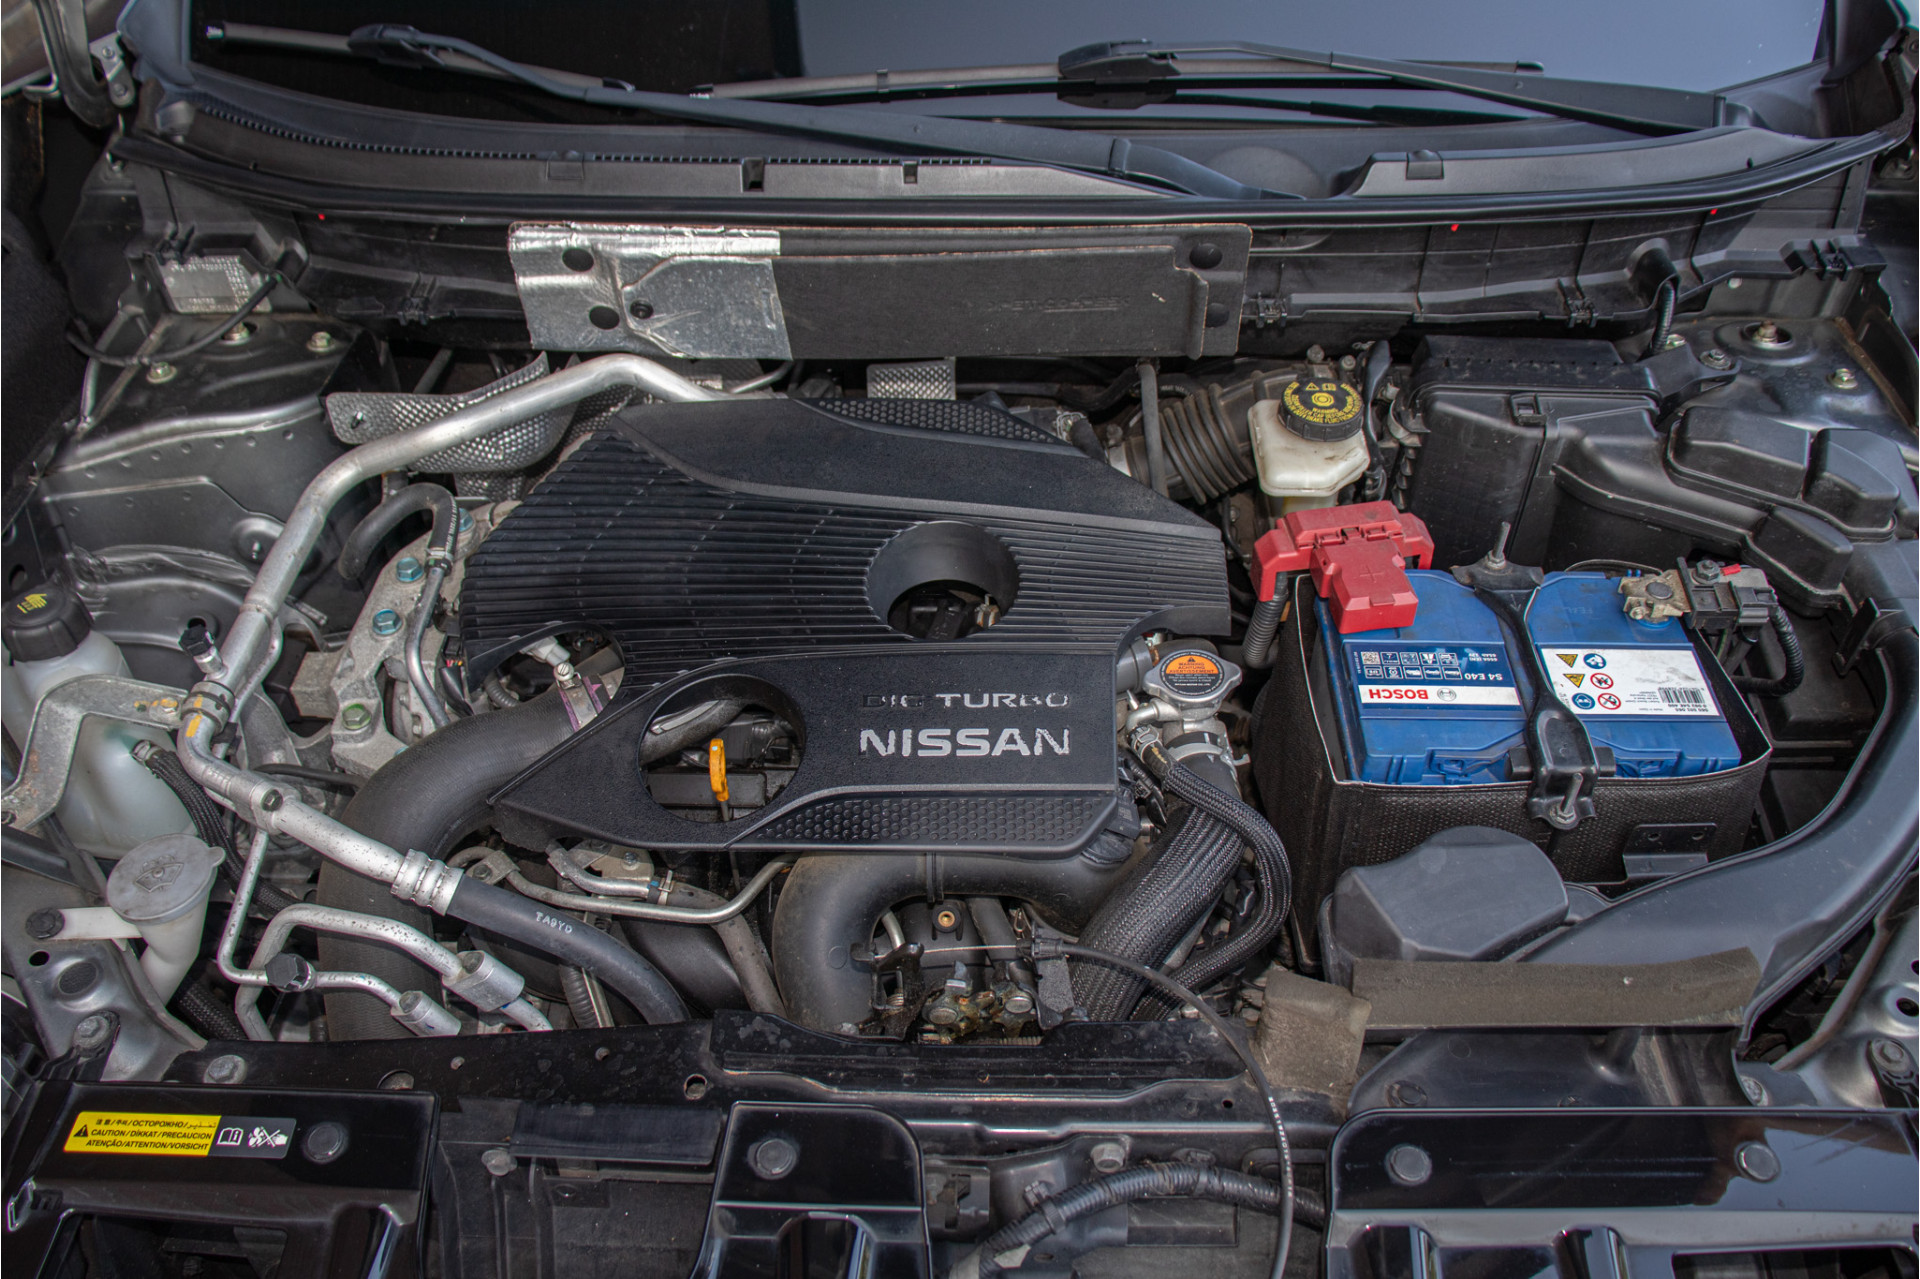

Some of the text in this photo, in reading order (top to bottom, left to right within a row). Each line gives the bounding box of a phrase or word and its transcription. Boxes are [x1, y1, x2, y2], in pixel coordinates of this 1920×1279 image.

[1464, 673, 1503, 681] S4 E40
[935, 692, 1069, 709] TURBO
[1368, 688, 1429, 700] BOSCH
[858, 728, 1069, 757] NISSAN
